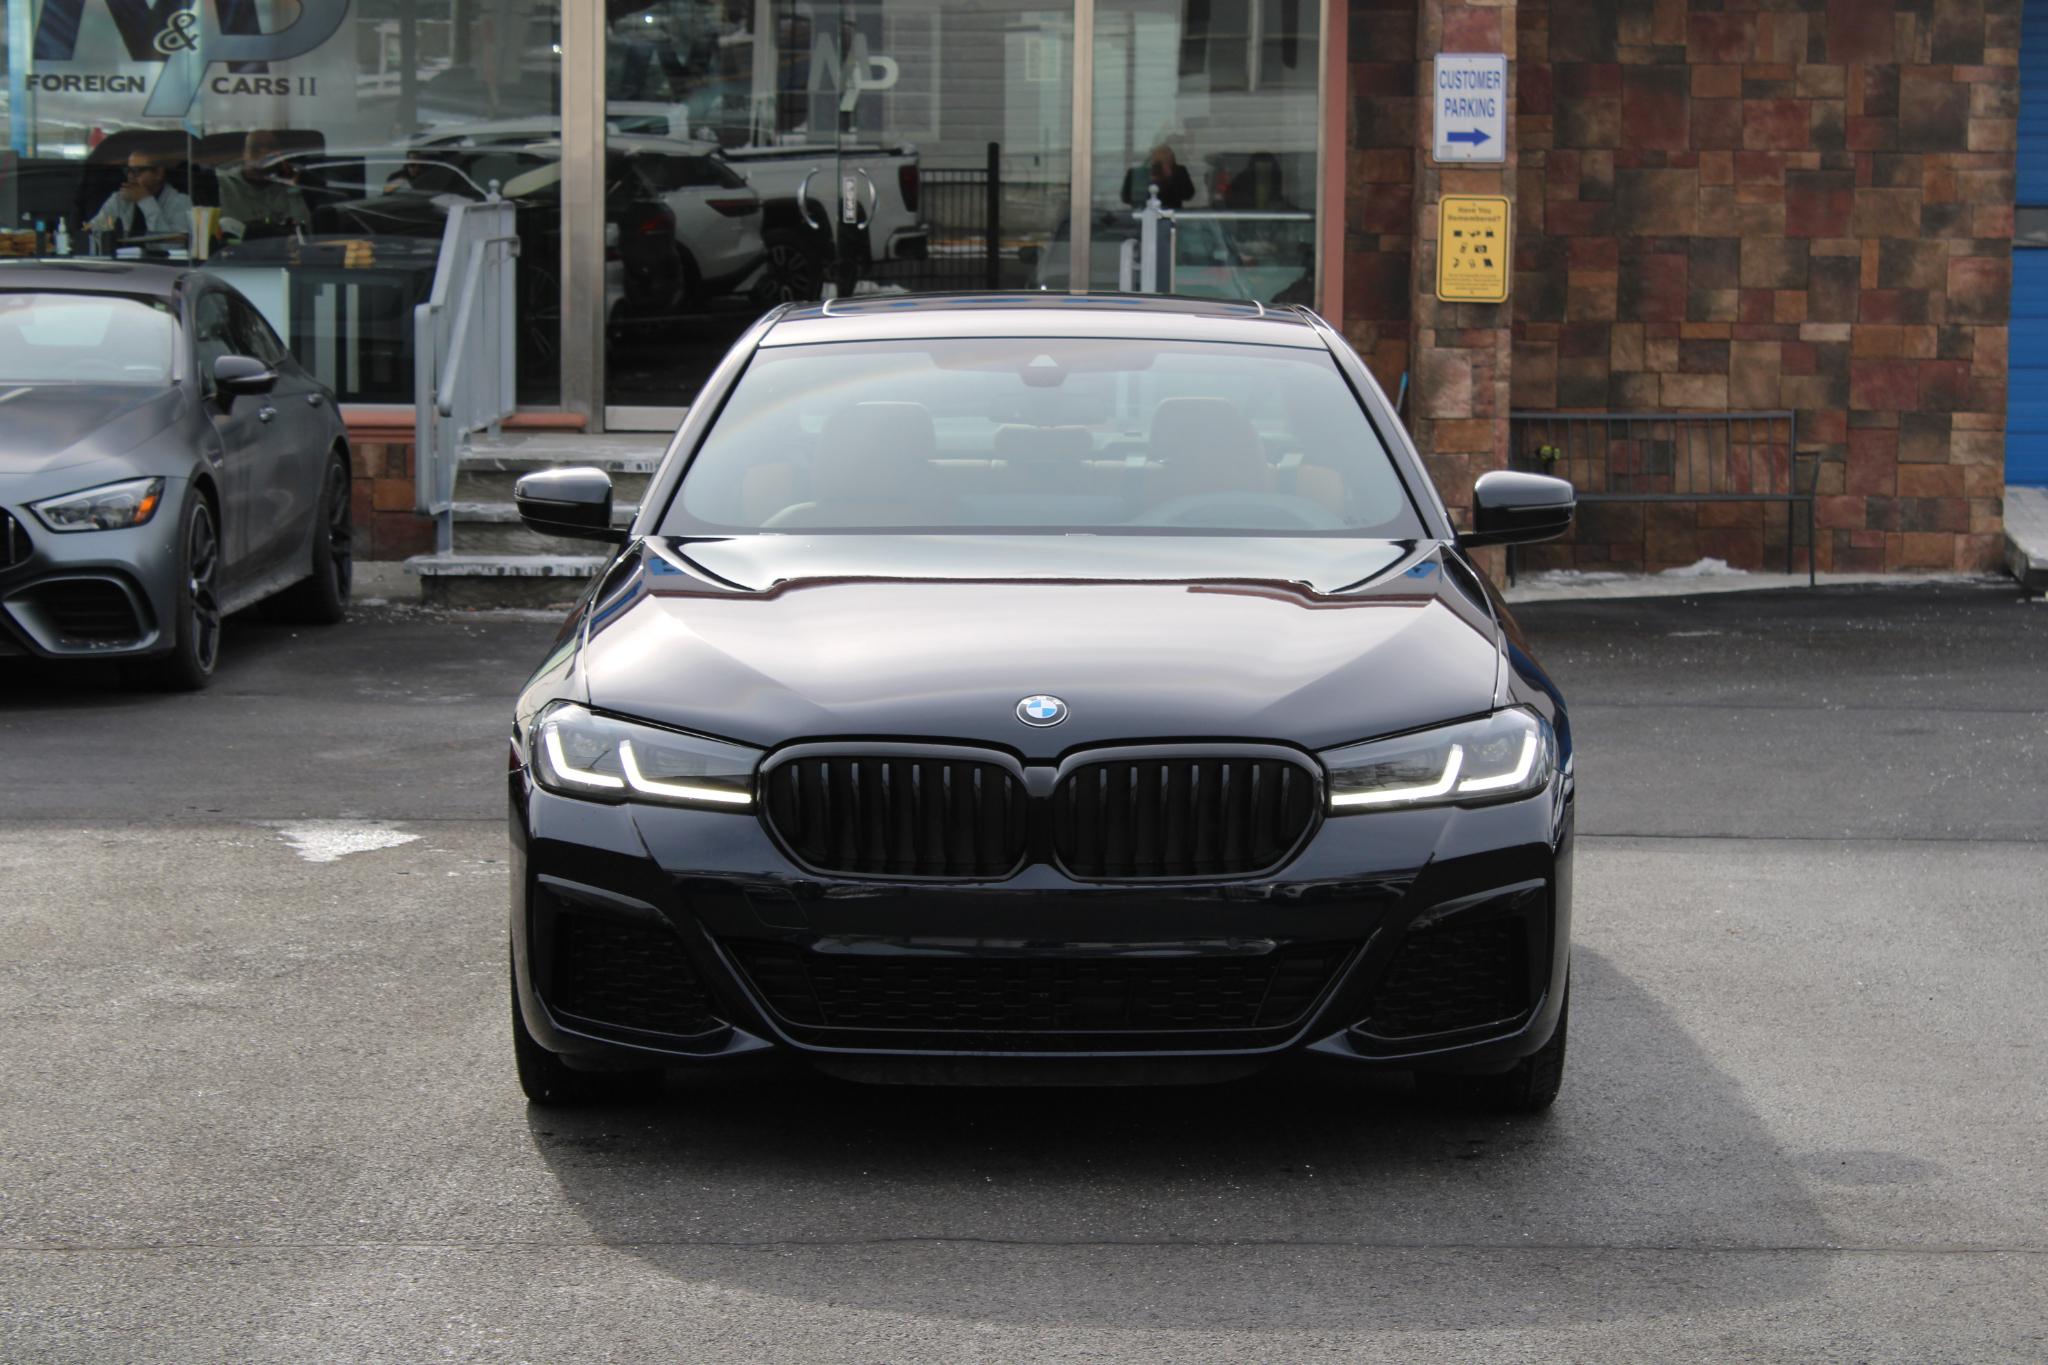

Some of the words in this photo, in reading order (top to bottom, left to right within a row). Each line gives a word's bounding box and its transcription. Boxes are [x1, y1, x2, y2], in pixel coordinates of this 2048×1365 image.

[25, 74, 146, 93] FOREIGN
[211, 77, 290, 96] CARS
[1439, 70, 1501, 89] CUSTOMER
[1444, 98, 1495, 117] PARKING
